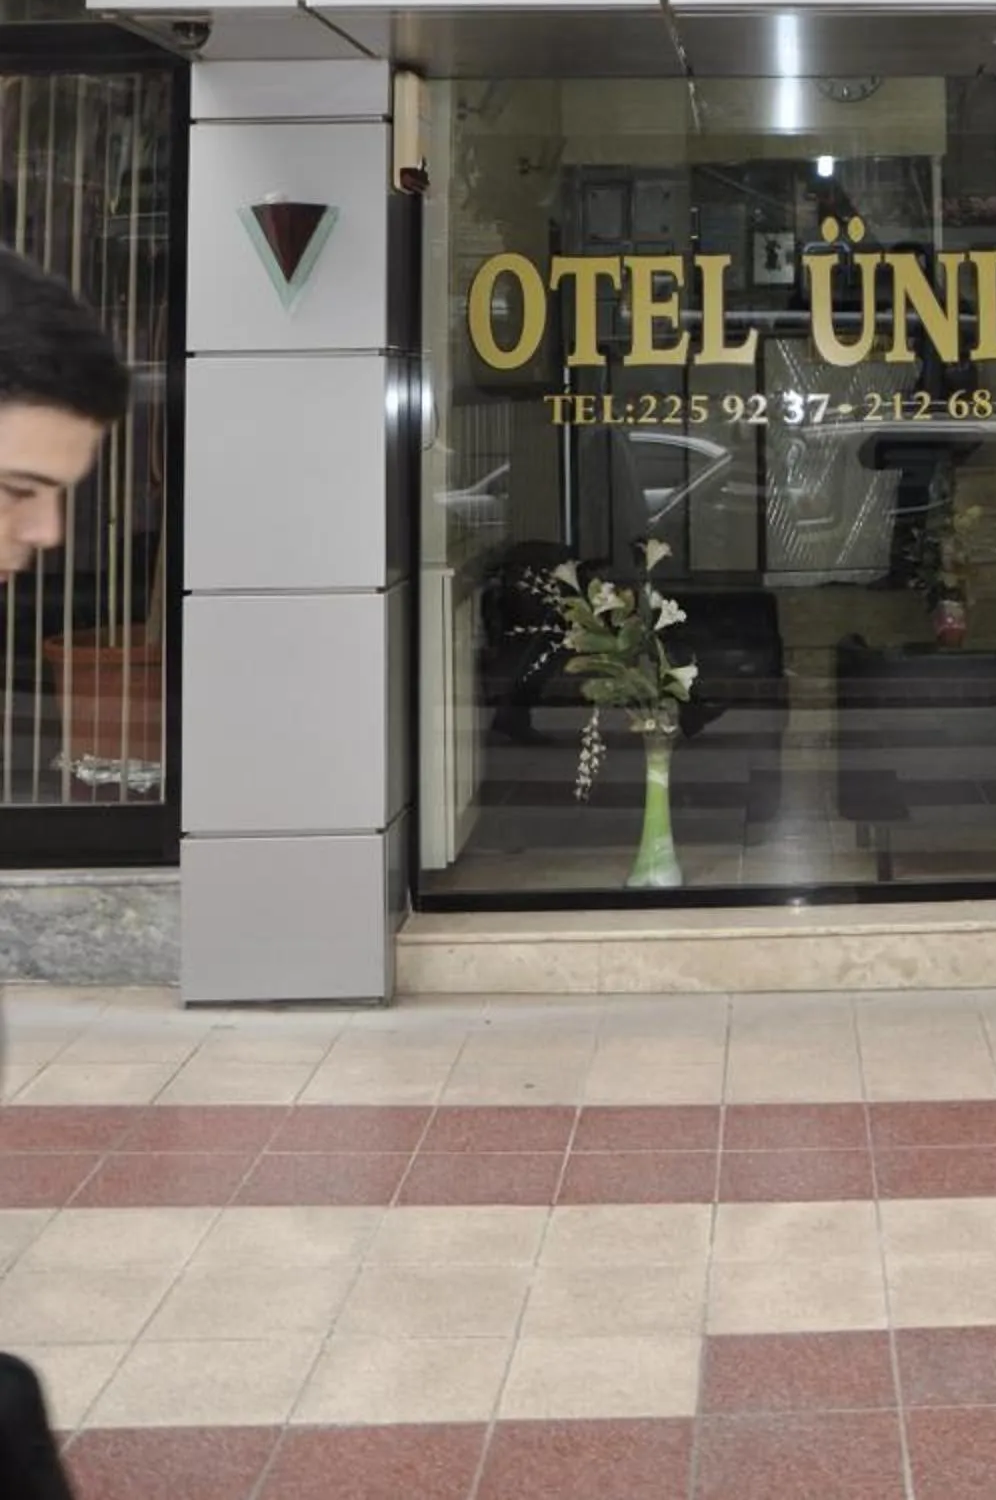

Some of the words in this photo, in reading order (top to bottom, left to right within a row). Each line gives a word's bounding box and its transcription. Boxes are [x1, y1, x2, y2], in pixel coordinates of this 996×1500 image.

[468, 253, 758, 370] OTEL
[543, 394, 709, 425] TEL:225
[722, 394, 769, 424] 92
[863, 392, 933, 422] 212
[948, 389, 993, 420] 68
